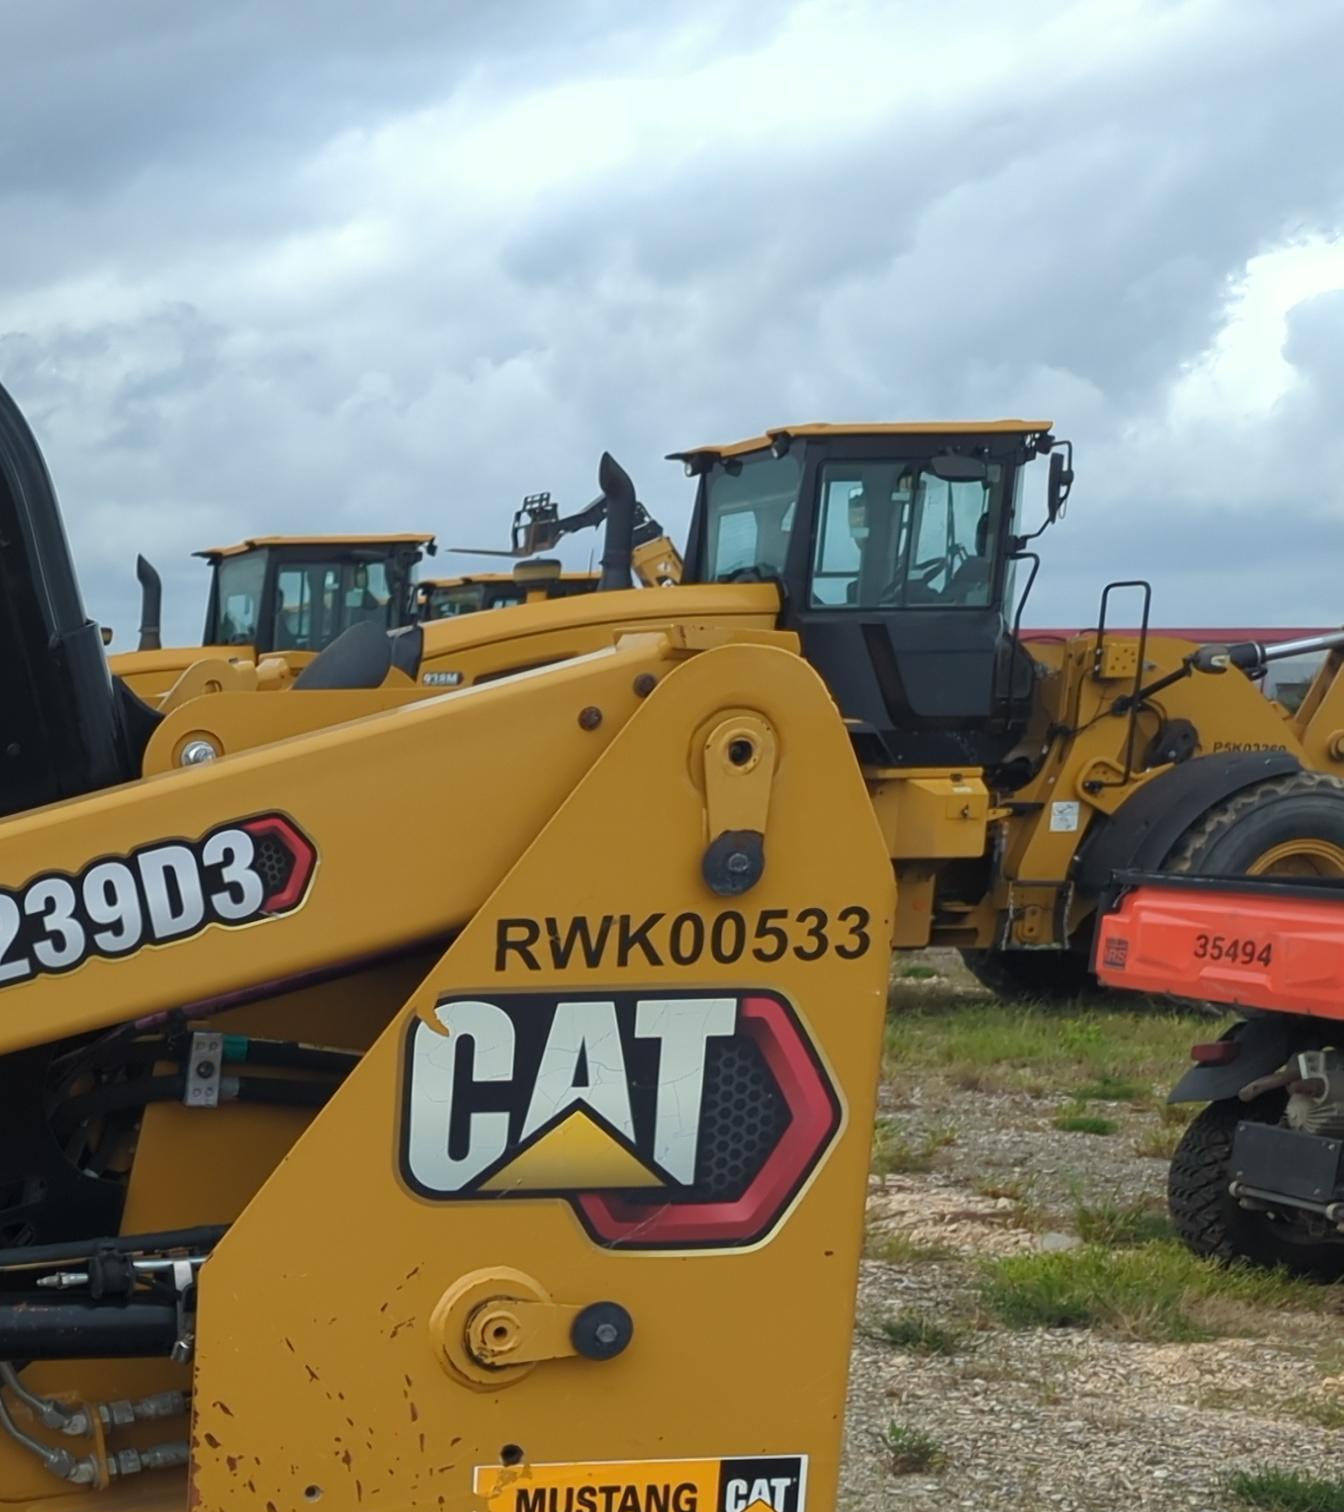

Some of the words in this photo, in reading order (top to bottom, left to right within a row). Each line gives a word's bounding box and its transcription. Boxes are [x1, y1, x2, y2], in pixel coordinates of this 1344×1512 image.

[494, 906, 871, 972] RWK00533
[1193, 933, 1273, 967] 35494
[409, 998, 738, 1192] CAT
